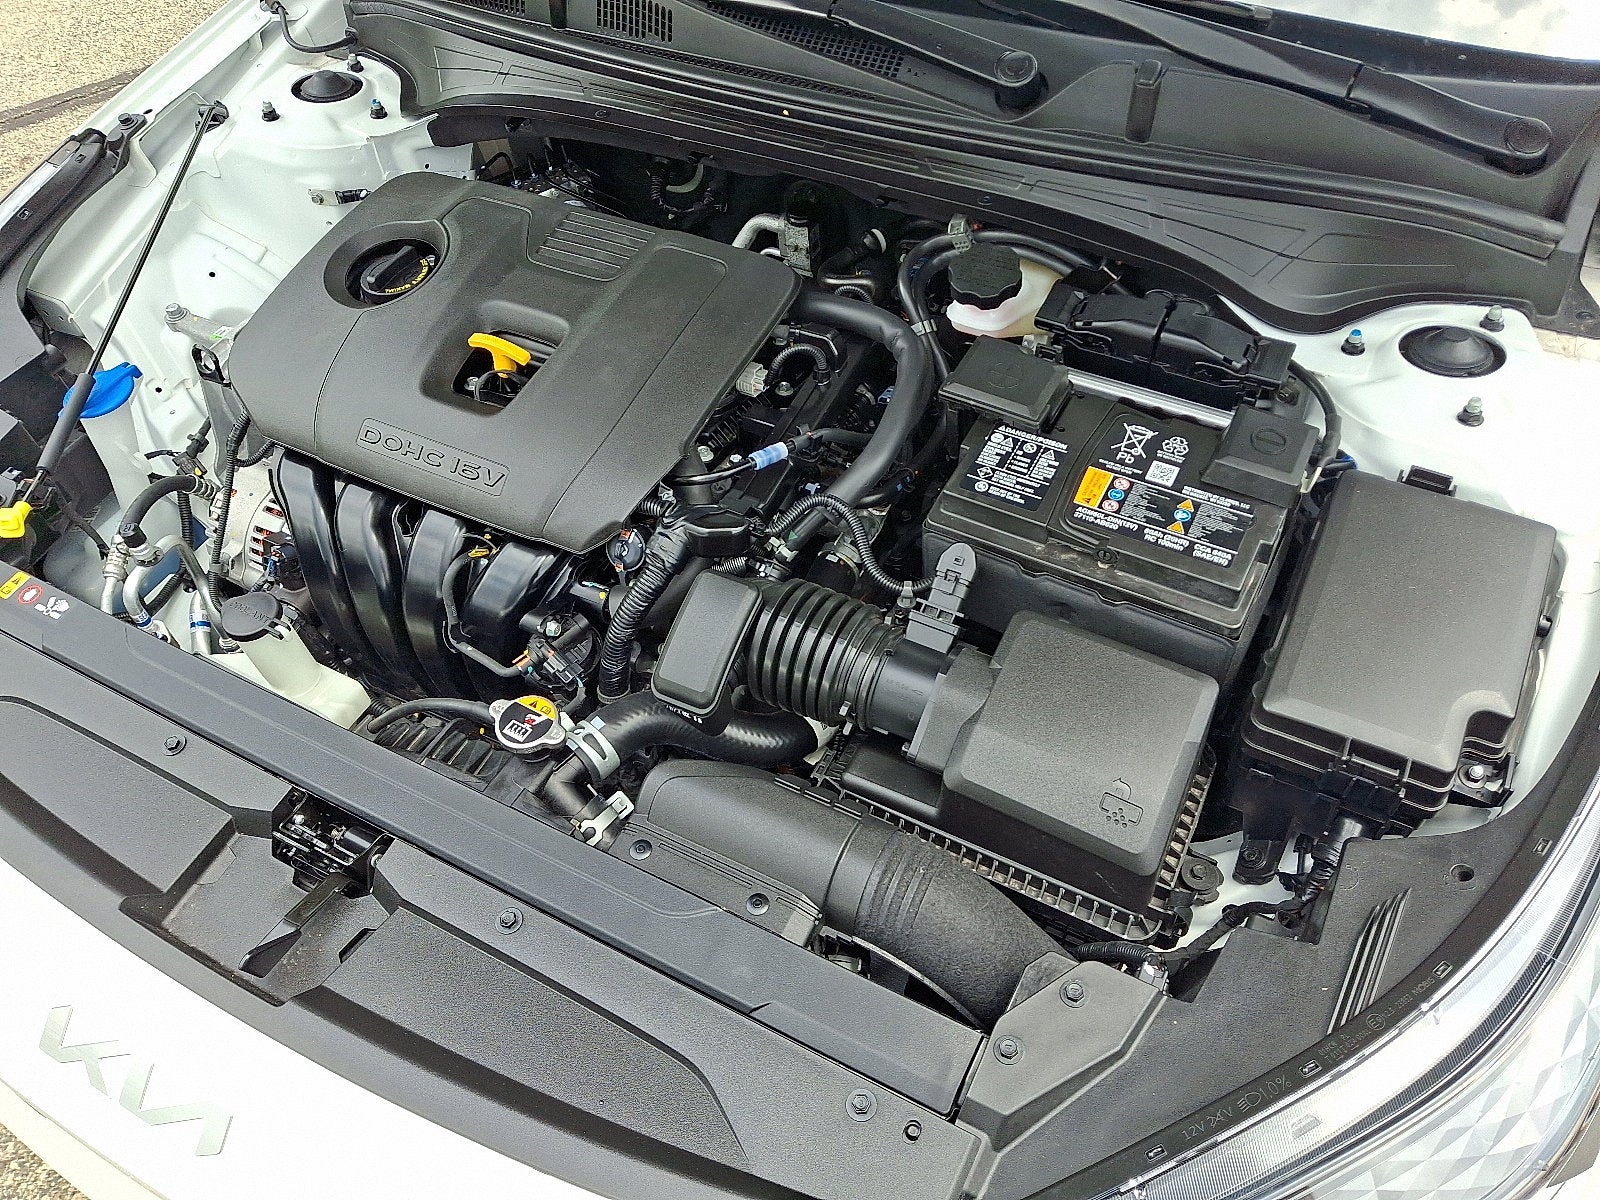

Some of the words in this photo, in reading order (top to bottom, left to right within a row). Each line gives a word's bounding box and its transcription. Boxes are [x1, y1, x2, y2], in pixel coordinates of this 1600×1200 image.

[1004, 426, 1068, 450] DANGER/POISON
[359, 424, 446, 468] DOHC
[450, 456, 506, 488] 16V
[1116, 452, 1135, 464] Pb
[1157, 538, 1184, 552] 100min
[1193, 543, 1212, 554] CCA
[1181, 1120, 1205, 1141] 12V
